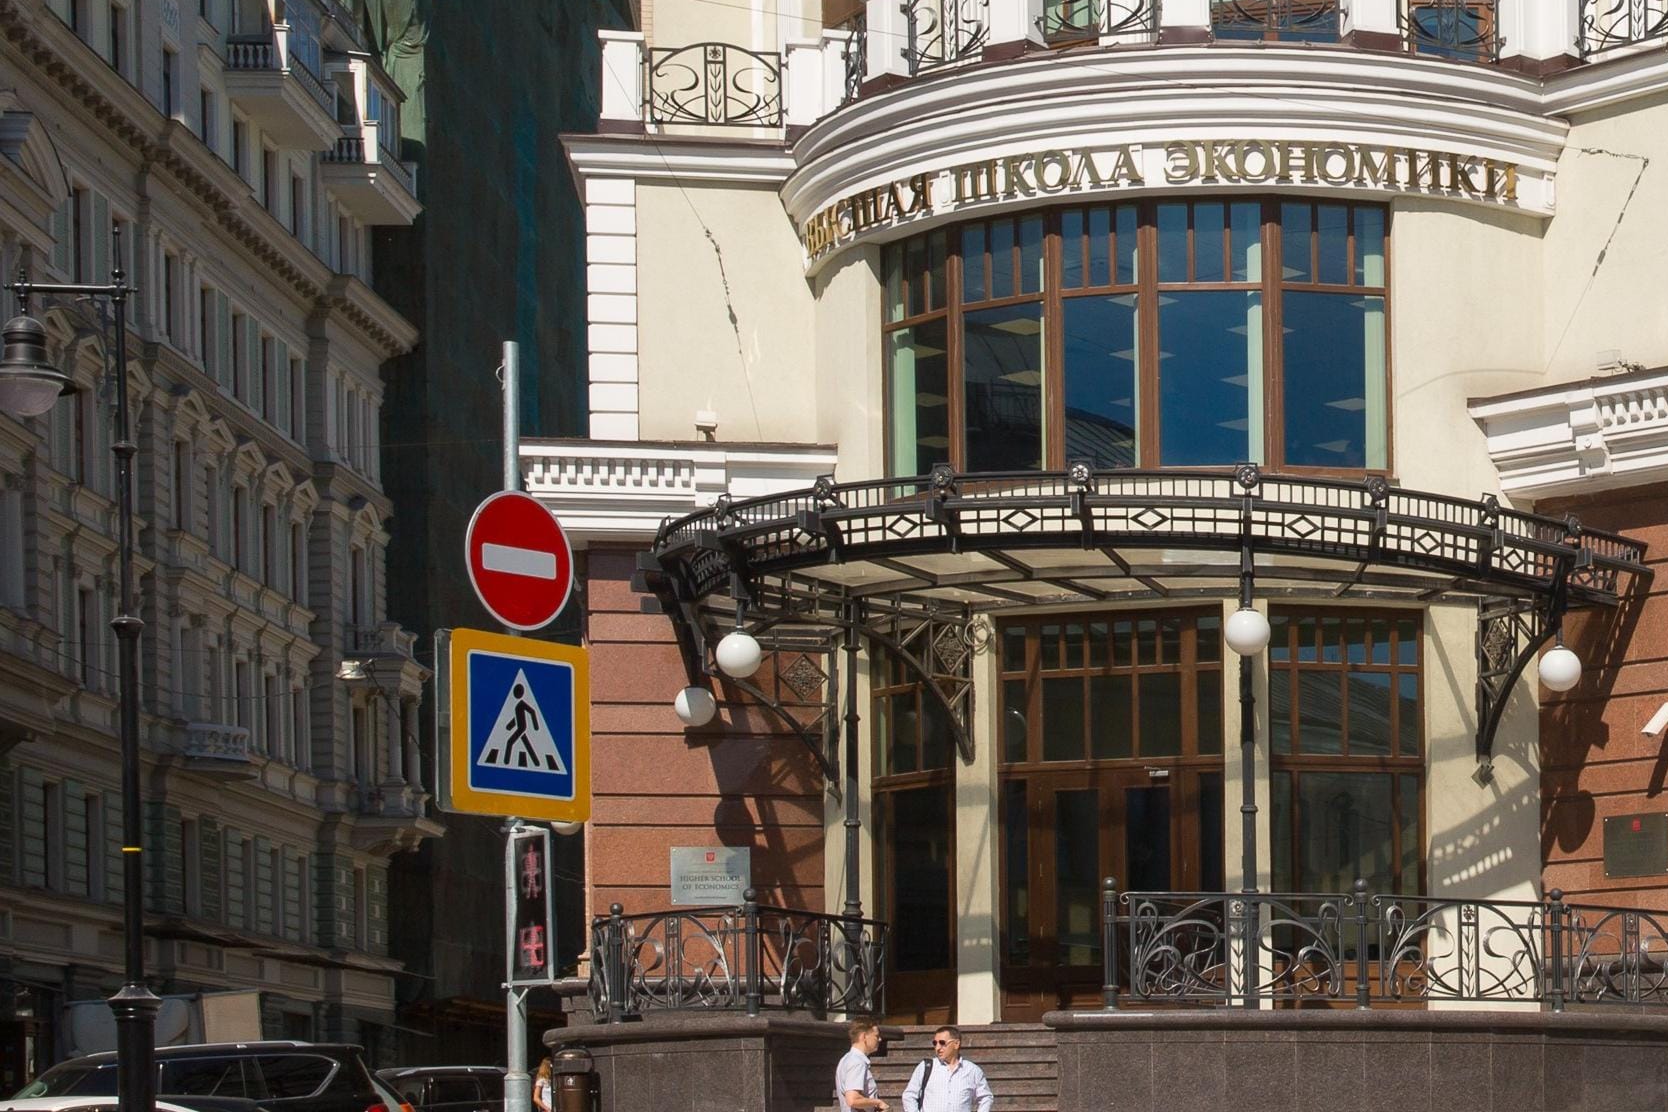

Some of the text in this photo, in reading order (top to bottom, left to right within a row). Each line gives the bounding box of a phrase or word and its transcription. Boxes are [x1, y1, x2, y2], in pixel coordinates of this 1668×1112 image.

[805, 138, 1519, 257] ВЫСШАЯ ШКОЛА ЭКОНОМИКИ
